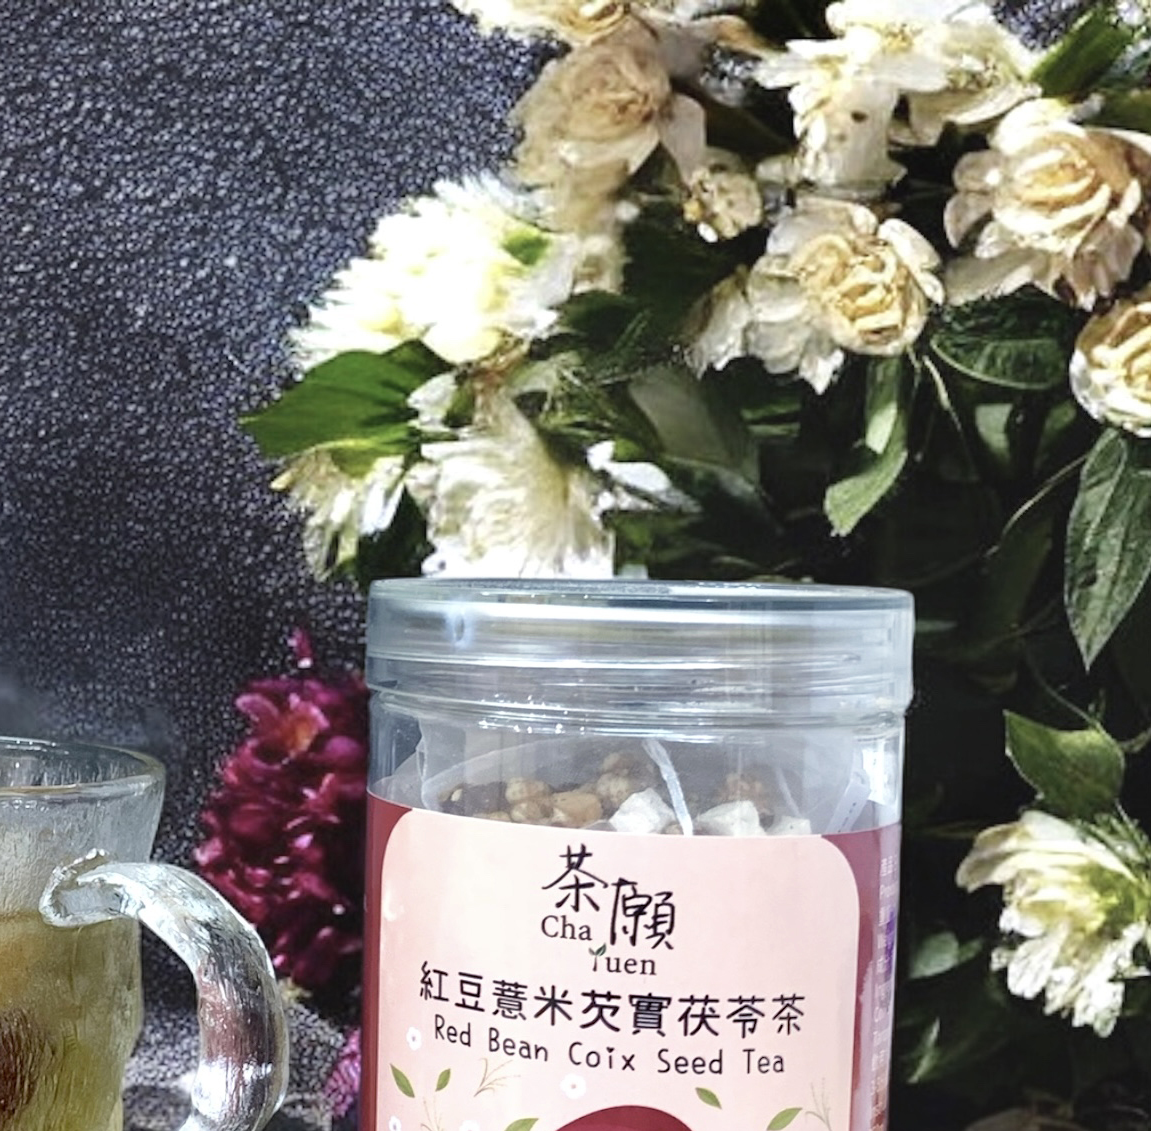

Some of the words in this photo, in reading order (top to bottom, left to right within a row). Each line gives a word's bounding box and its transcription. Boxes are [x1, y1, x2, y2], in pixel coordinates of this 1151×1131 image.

[541, 915, 593, 941] Cha
[588, 942, 657, 976] Yuen
[419, 960, 806, 1039] 紅豆薏米芡實茯苓茶
[434, 1013, 472, 1048] Red
[488, 1027, 549, 1062] Bean
[568, 1041, 636, 1071] Coix
[657, 1048, 724, 1075] Seed
[742, 1048, 785, 1075] Tea
